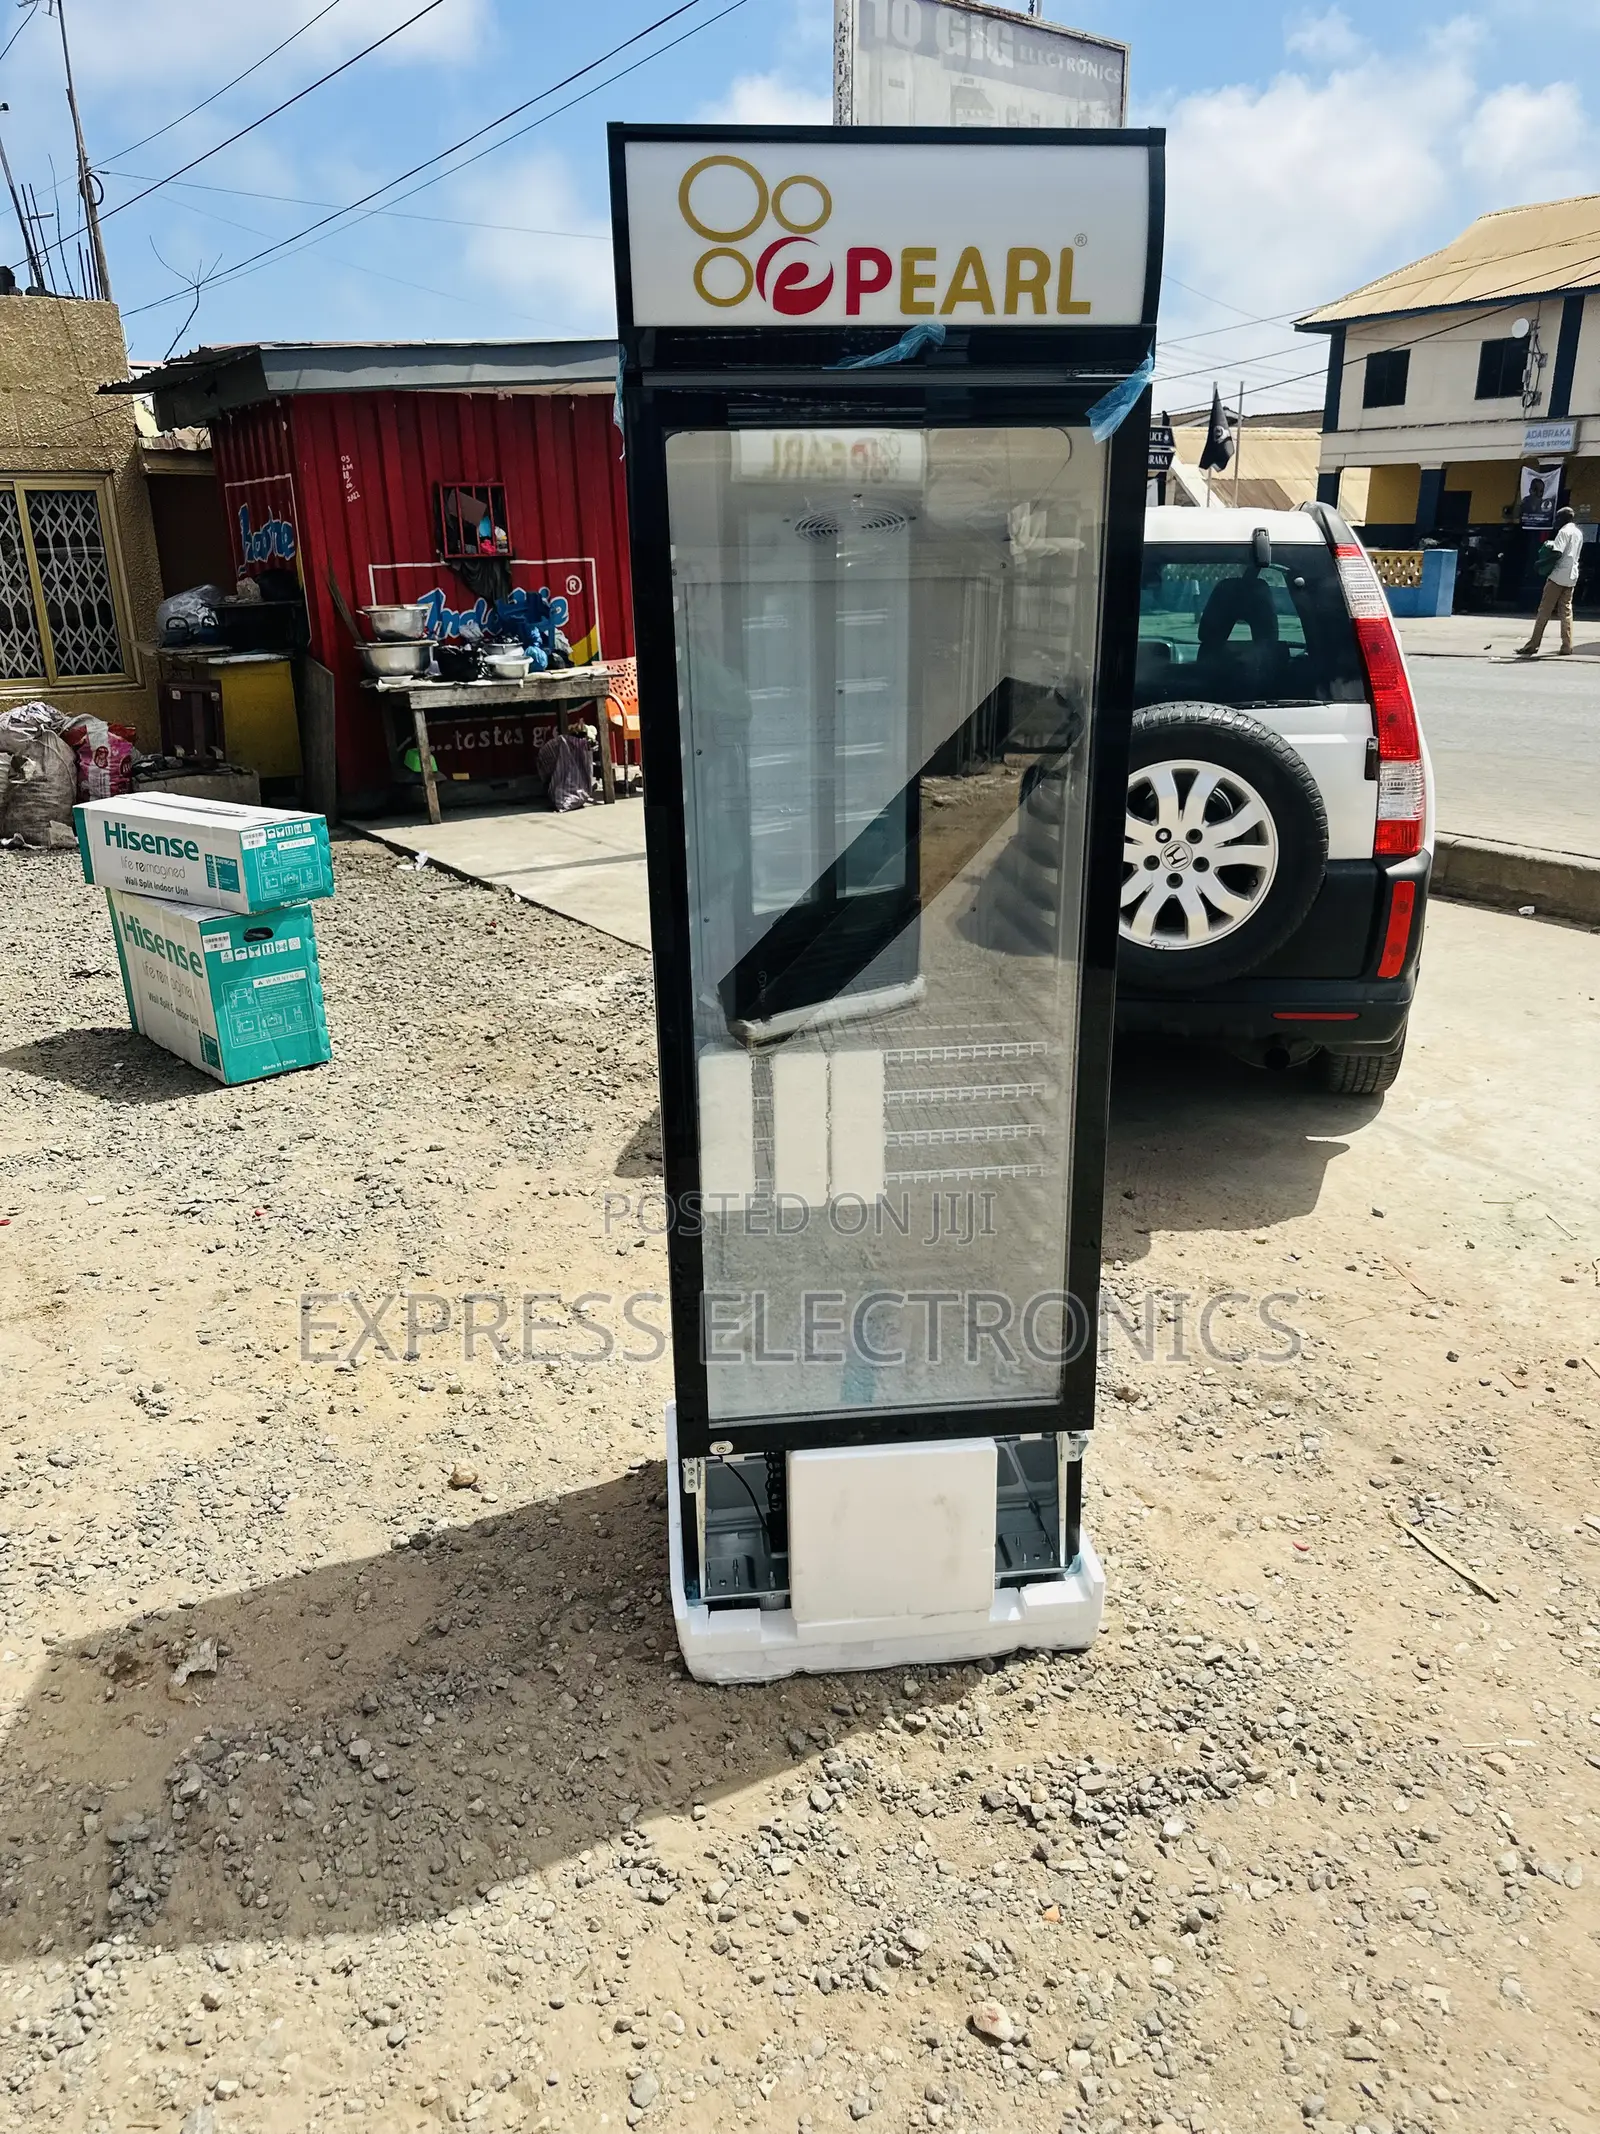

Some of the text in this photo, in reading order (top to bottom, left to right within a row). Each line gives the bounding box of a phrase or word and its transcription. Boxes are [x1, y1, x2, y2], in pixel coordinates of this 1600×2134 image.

[1019, 44, 1121, 84] ELECTRONICS
[846, 247, 1091, 315] PEARL
[1526, 428, 1571, 440] ADABRAKA
[103, 820, 199, 862] Hisense
[121, 856, 186, 879] life reimagined
[124, 876, 189, 897] Wall Split Indoor Unit
[120, 911, 204, 979] Hisense
[265, 973, 301, 984] WARNING
